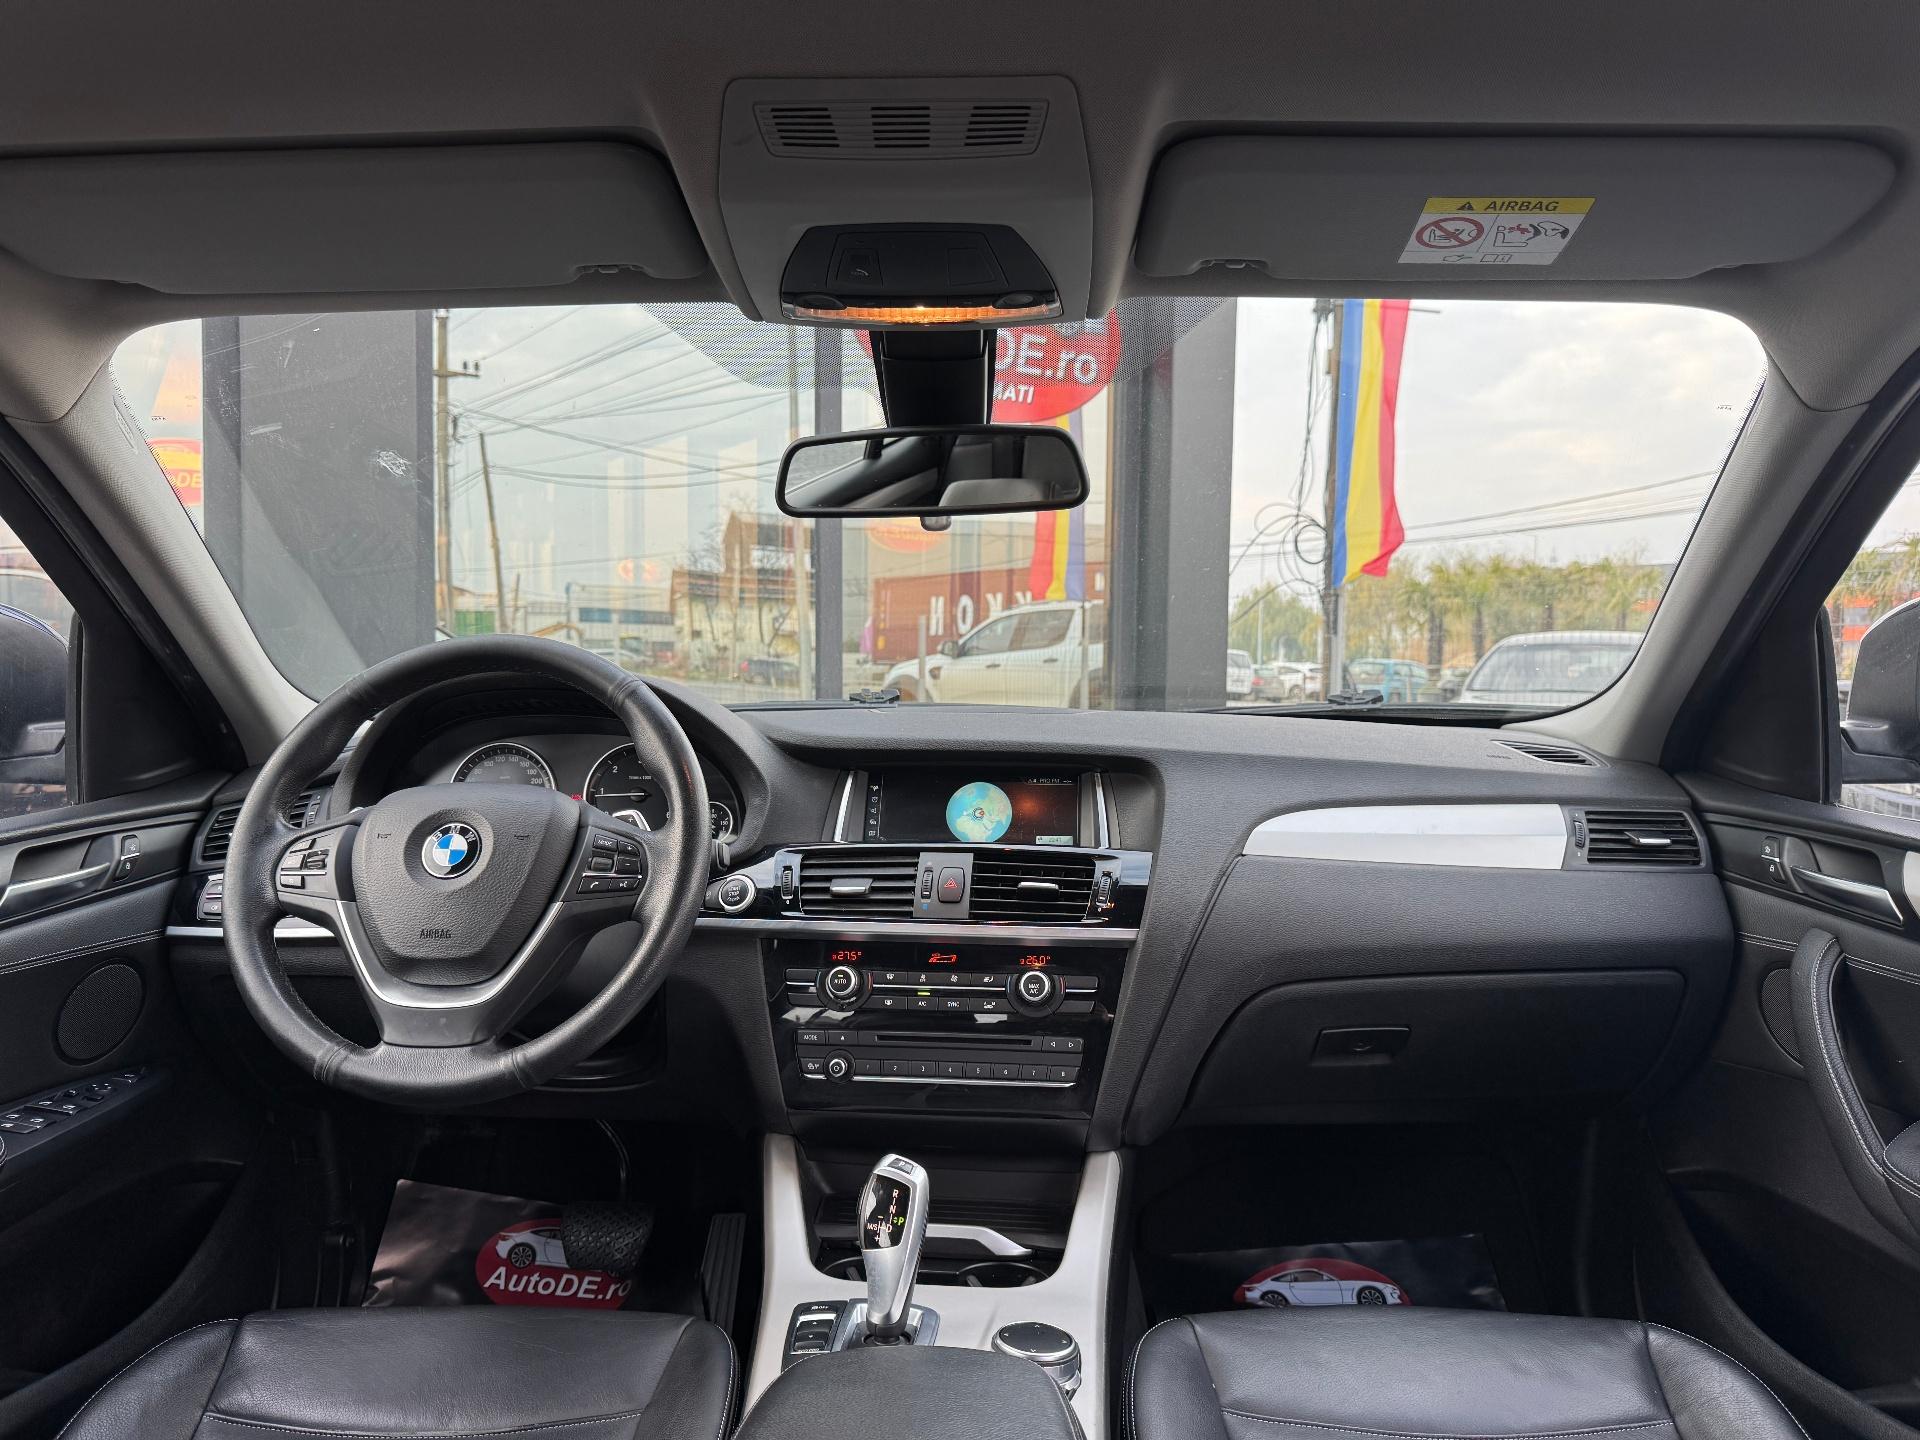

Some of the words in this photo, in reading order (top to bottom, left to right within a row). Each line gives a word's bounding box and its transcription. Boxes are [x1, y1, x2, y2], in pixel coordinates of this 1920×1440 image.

[1484, 201, 1559, 212] AIRBAG
[431, 825, 476, 842] BMW
[420, 928, 452, 939] AIRBAG
[892, 1189, 898, 1198] R
[890, 1204, 896, 1214] N
[898, 1216, 904, 1225] P
[886, 1224, 892, 1232] D
[483, 1266, 632, 1300] AutoDE.ro
